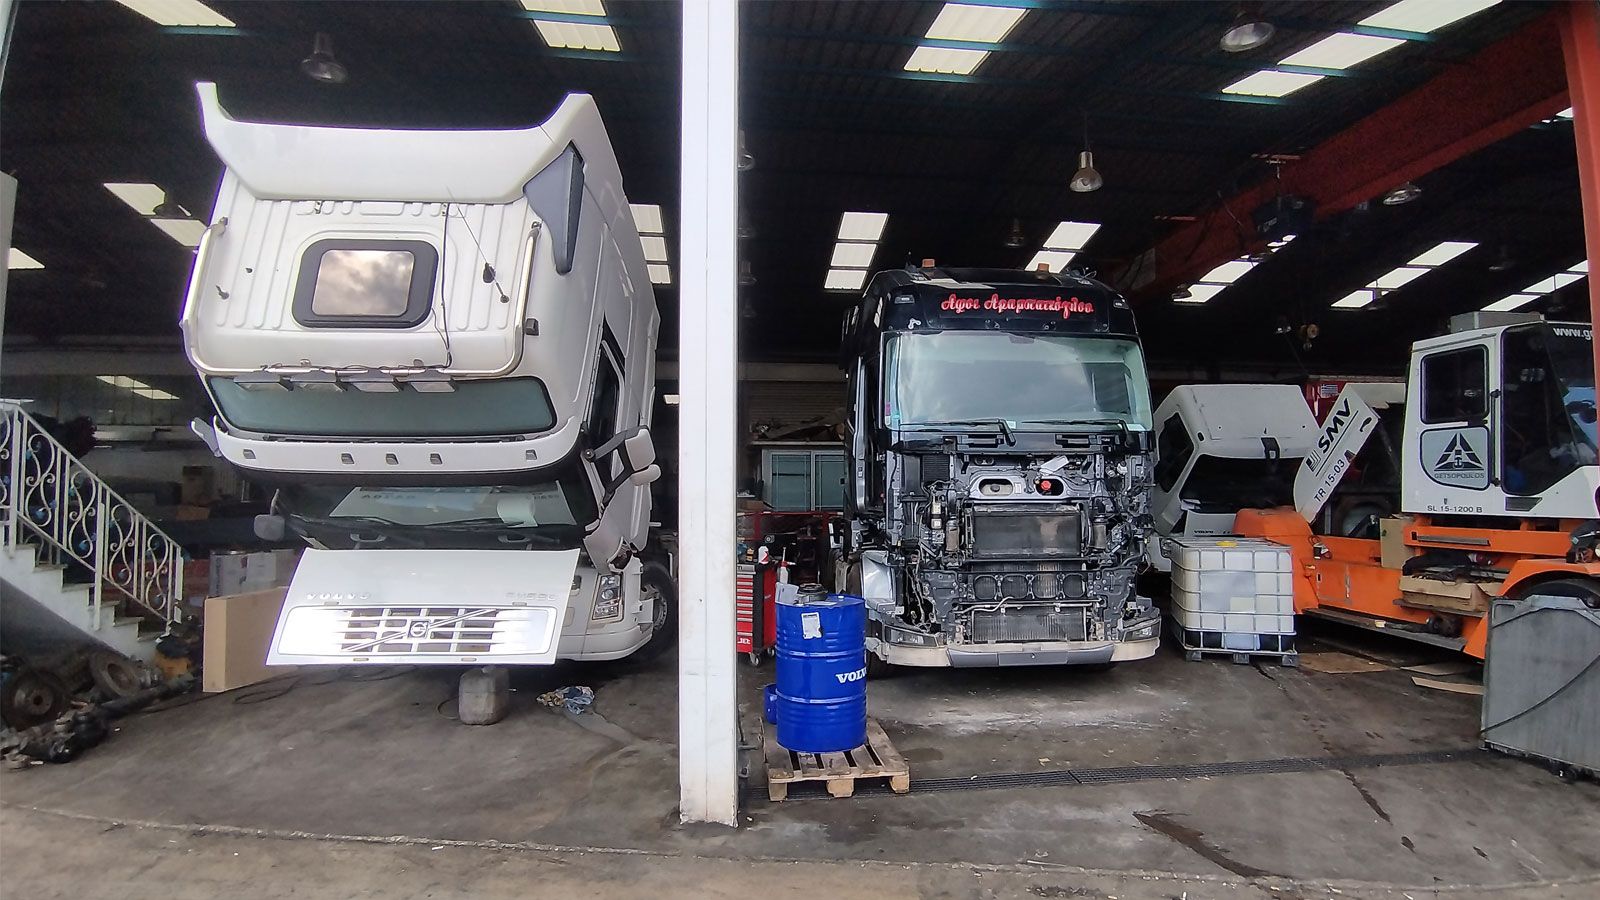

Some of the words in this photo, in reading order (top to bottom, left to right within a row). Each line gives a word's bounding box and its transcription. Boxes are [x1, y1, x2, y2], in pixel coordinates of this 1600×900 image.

[1318, 398, 1351, 454] SMV
[1314, 488, 1327, 502] TR
[1325, 459, 1345, 487] 15-03
[1440, 505, 1474, 513] 15-1200
